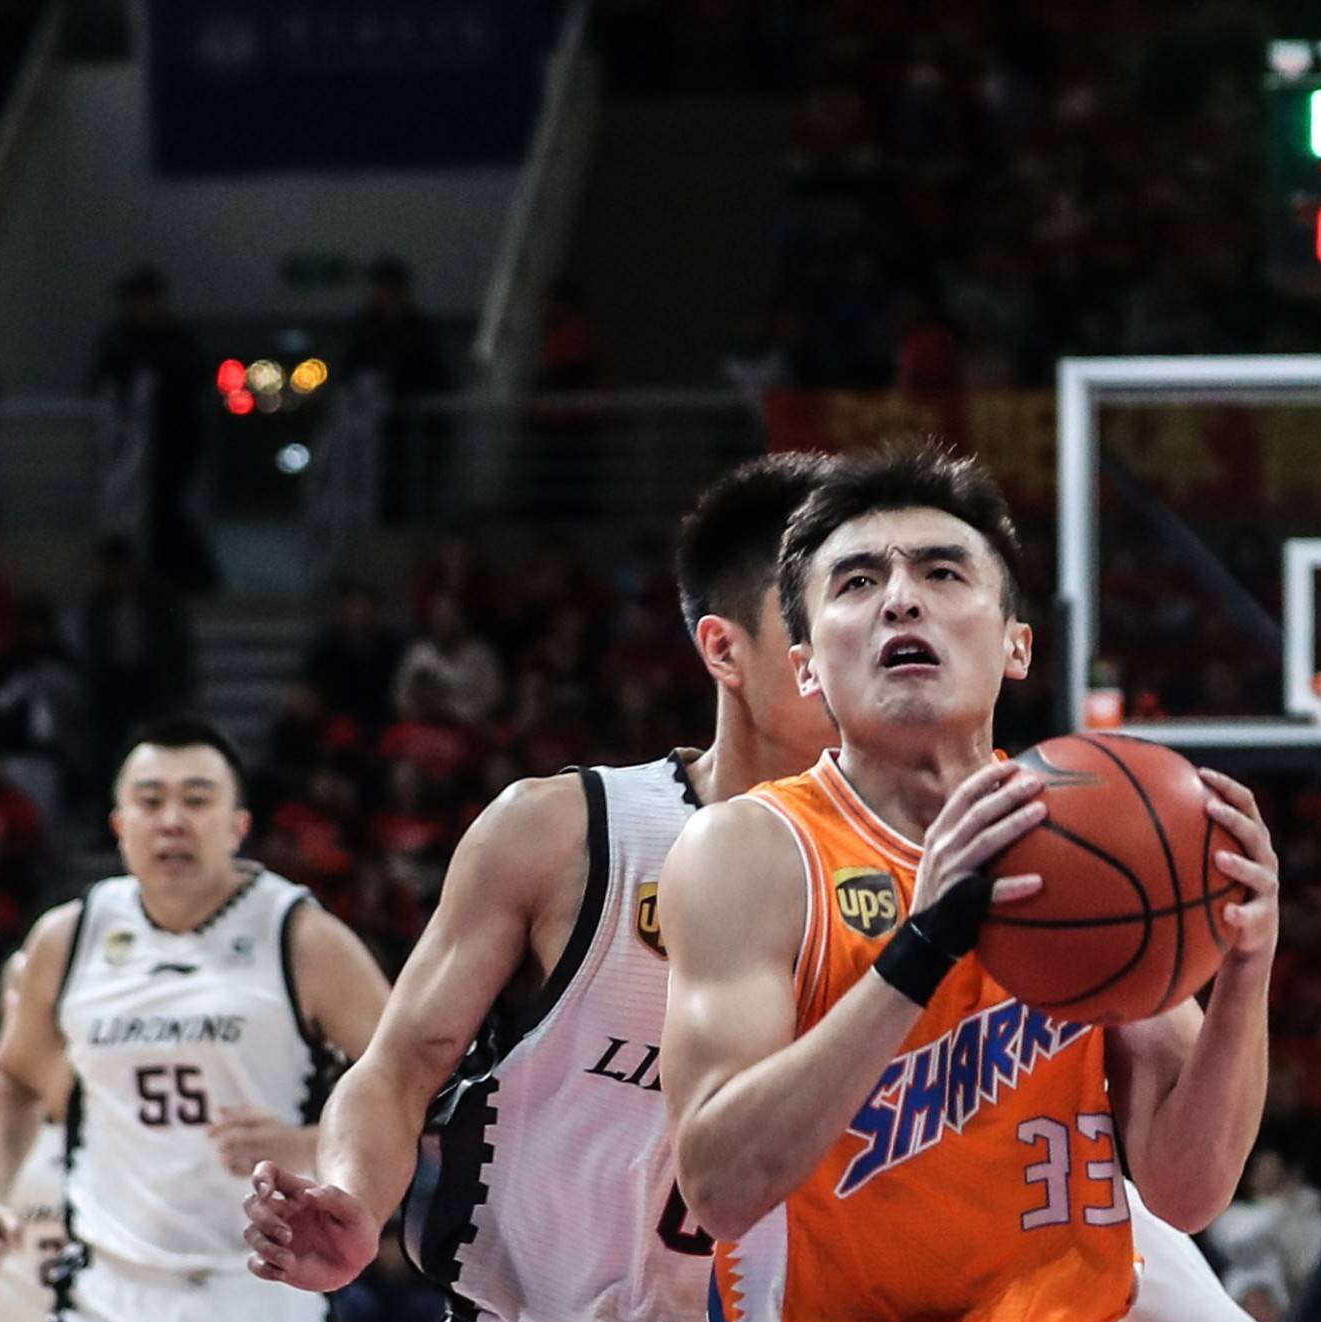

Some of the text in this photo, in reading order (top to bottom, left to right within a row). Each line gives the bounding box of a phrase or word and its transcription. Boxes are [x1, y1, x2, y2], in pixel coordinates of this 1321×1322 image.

[838, 888, 896, 929] ups
[134, 1064, 212, 1127] 55
[1016, 1112, 1131, 1232] 33
